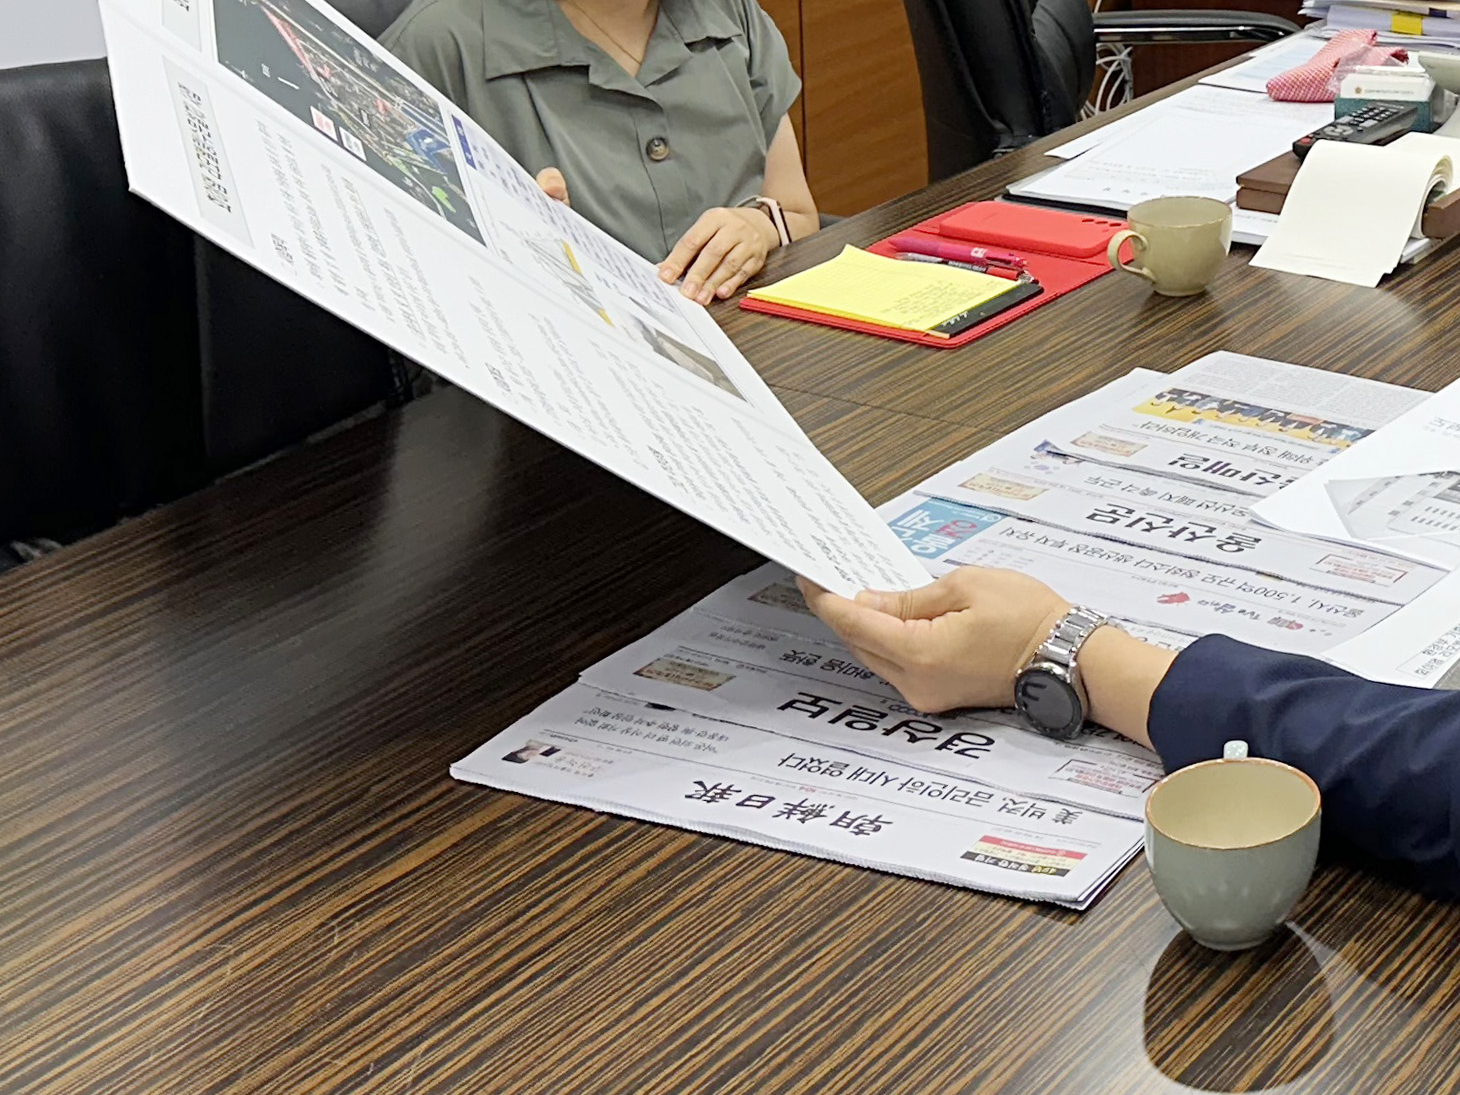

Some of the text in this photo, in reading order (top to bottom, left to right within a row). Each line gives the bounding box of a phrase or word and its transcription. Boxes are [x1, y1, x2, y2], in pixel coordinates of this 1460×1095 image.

[1085, 503, 1262, 553] 울산신문
[1035, 534, 1068, 550] 투자
[1068, 543, 1134, 565] 생산공장
[1200, 573, 1236, 590] 규모
[776, 692, 997, 759] 경상일보
[777, 752, 846, 778] 열었다
[849, 767, 901, 788] 시대
[898, 777, 996, 808] 금리인하
[684, 780, 894, 837] 朝鮮日報
[1053, 807, 1084, 826] 美
